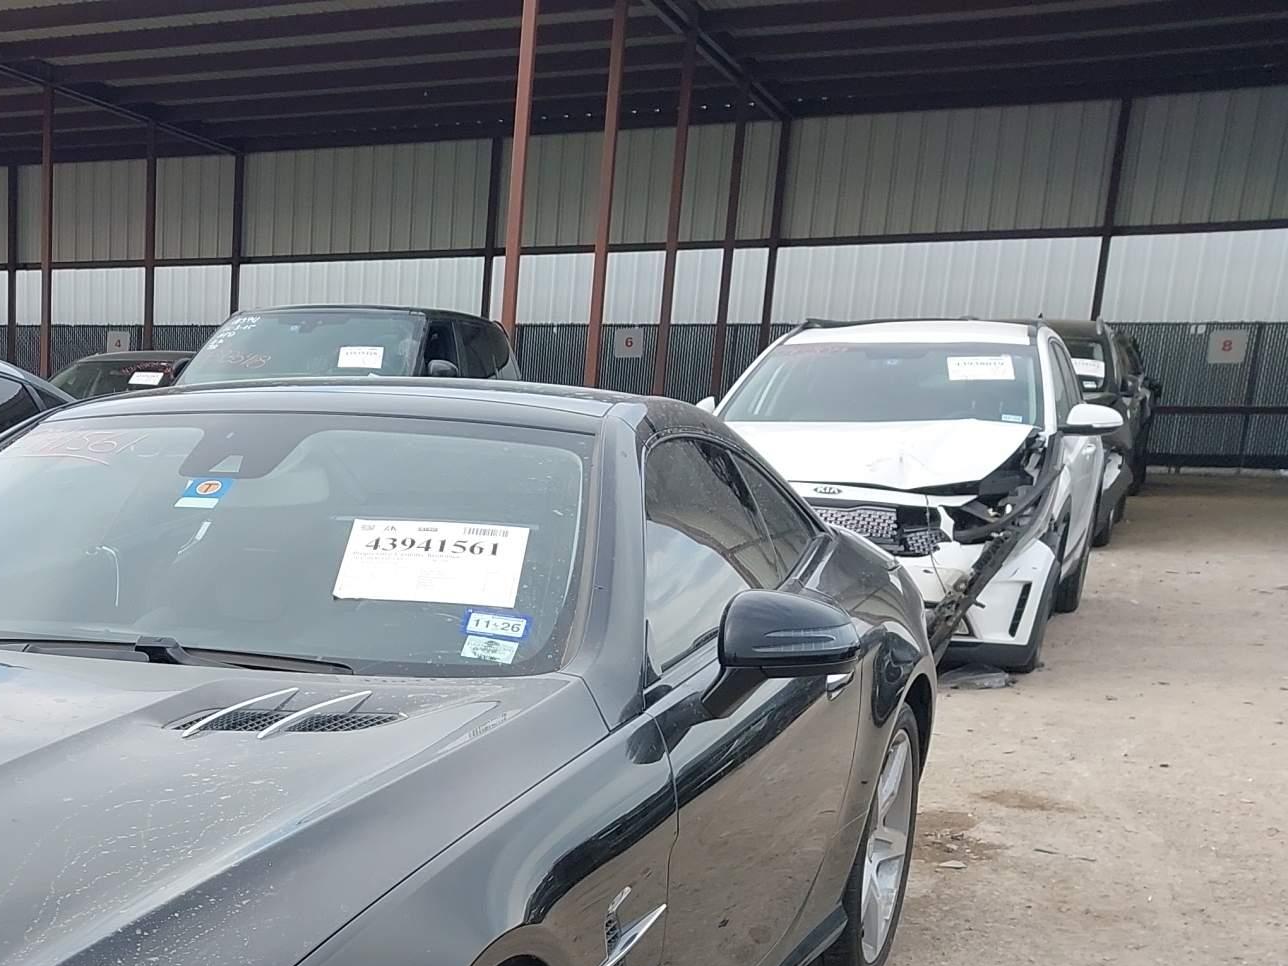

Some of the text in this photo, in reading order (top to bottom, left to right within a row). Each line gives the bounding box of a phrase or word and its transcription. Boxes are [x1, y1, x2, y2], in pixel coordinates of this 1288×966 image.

[114, 339, 122, 348] 4
[624, 336, 634, 348] 6
[1222, 339, 1233, 352] 8
[813, 486, 843, 495] KIA
[364, 536, 500, 557] 43941561
